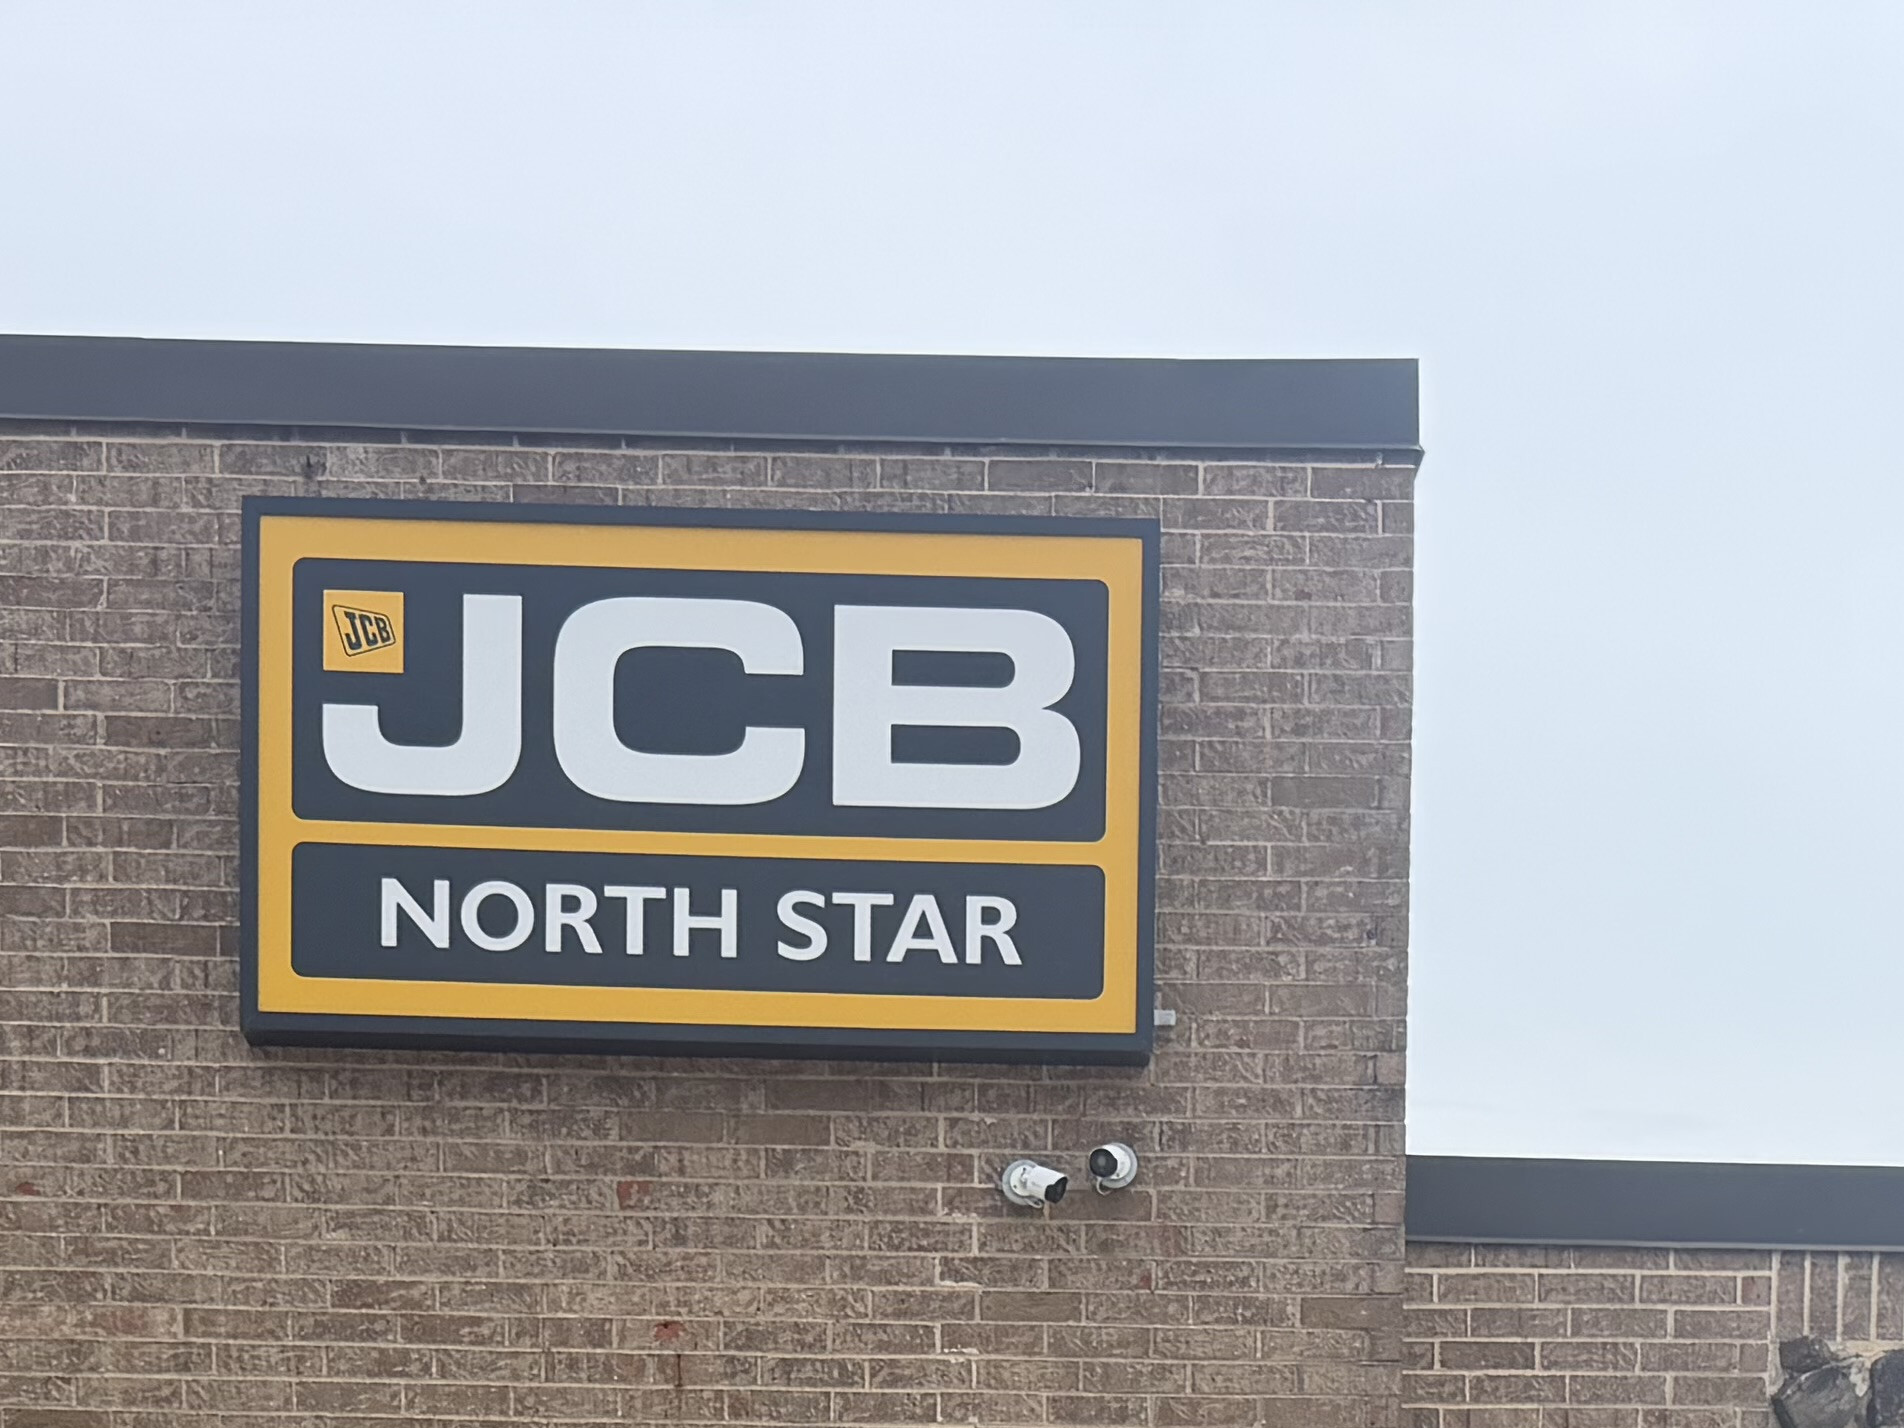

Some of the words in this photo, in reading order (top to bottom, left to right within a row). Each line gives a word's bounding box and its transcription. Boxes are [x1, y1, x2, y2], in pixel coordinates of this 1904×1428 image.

[343, 610, 392, 651] JCB
[322, 593, 1082, 810] JCB
[380, 877, 739, 959] NORTH
[776, 889, 1023, 966] STAR
